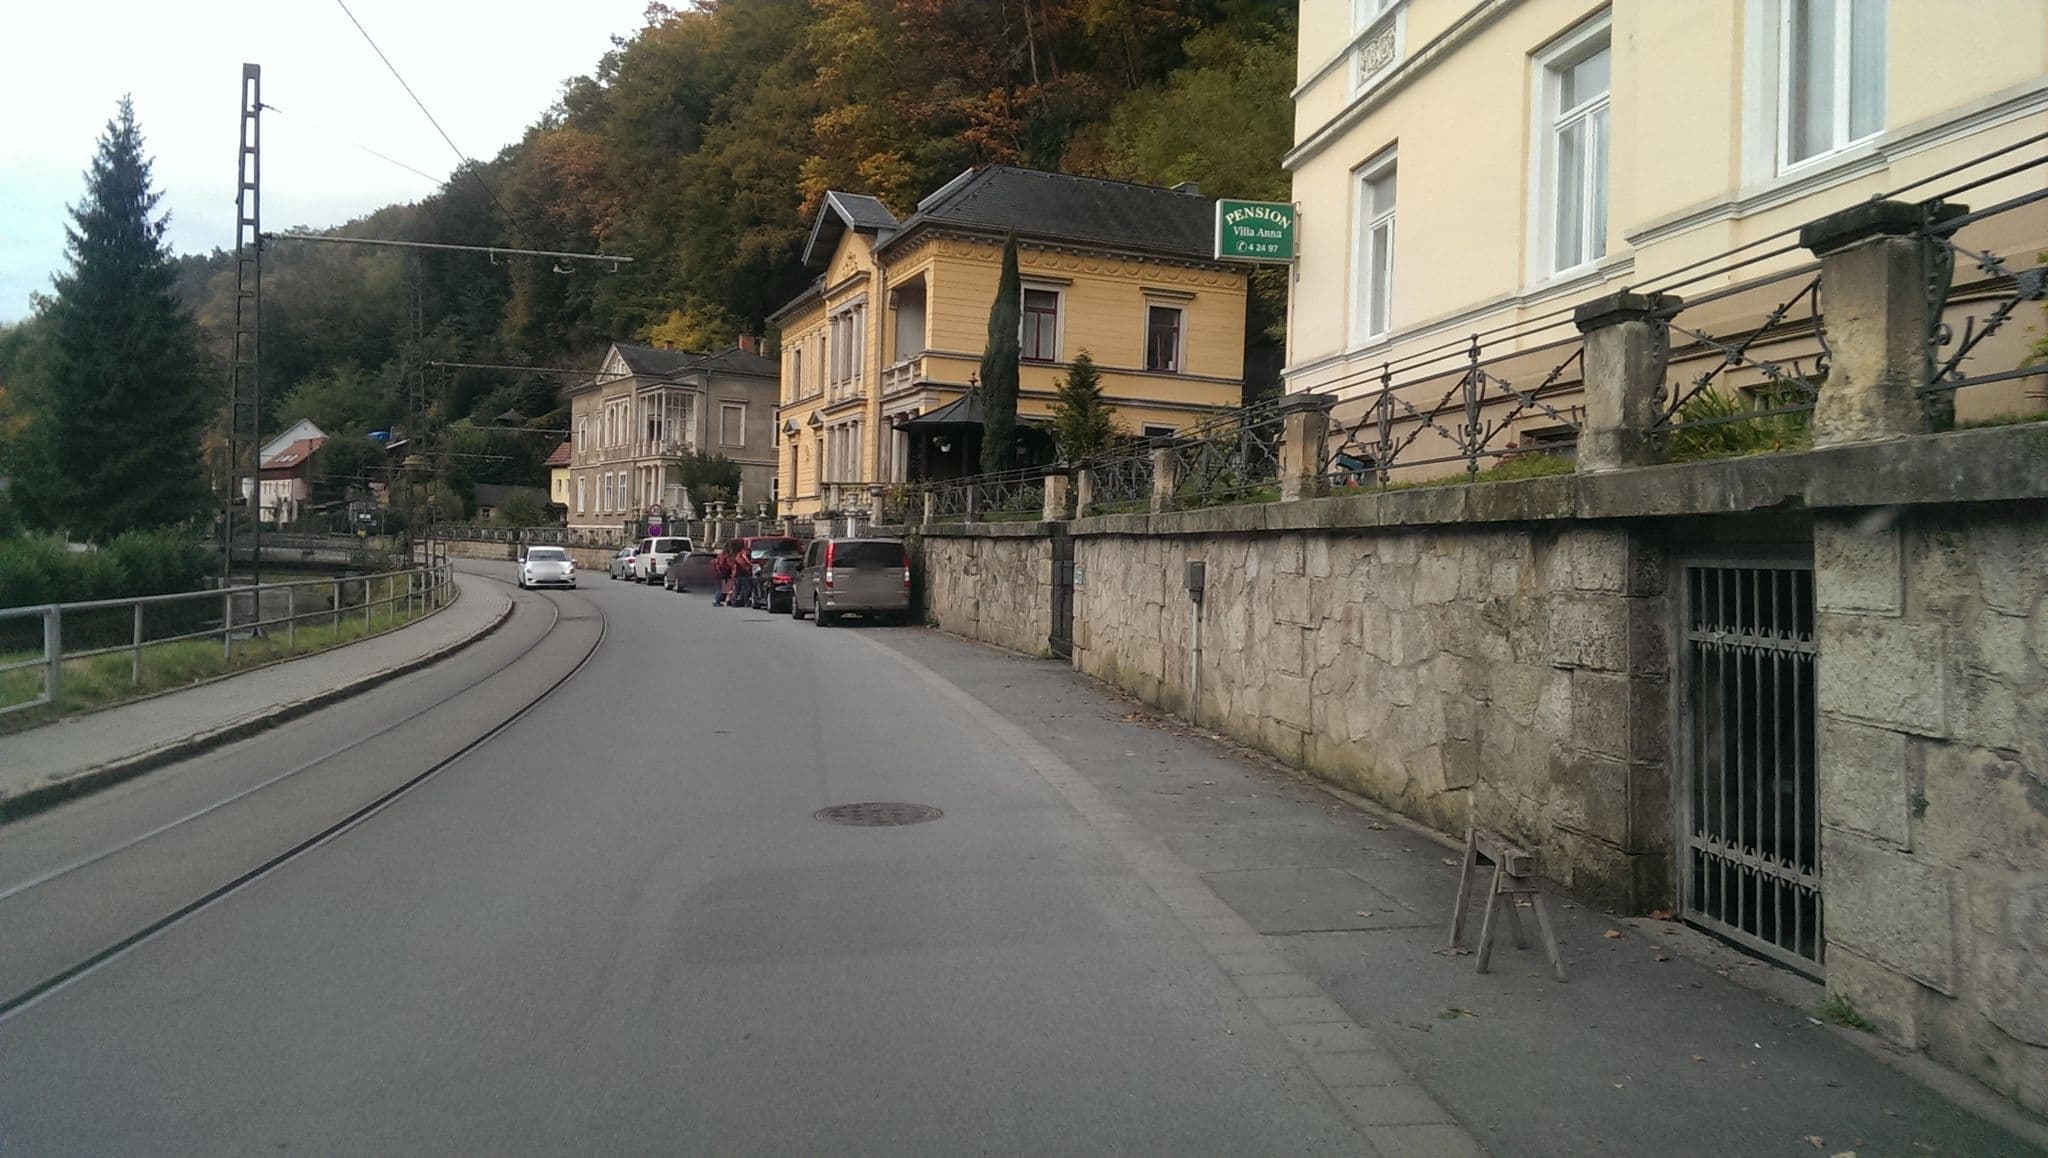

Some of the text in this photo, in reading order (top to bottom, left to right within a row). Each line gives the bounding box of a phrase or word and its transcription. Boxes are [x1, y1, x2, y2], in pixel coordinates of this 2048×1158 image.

[1225, 207, 1292, 229] PENSION
[1233, 226, 1282, 238] Villa Anna
[1248, 243, 1254, 251] 4
[1268, 244, 1278, 252] 97
